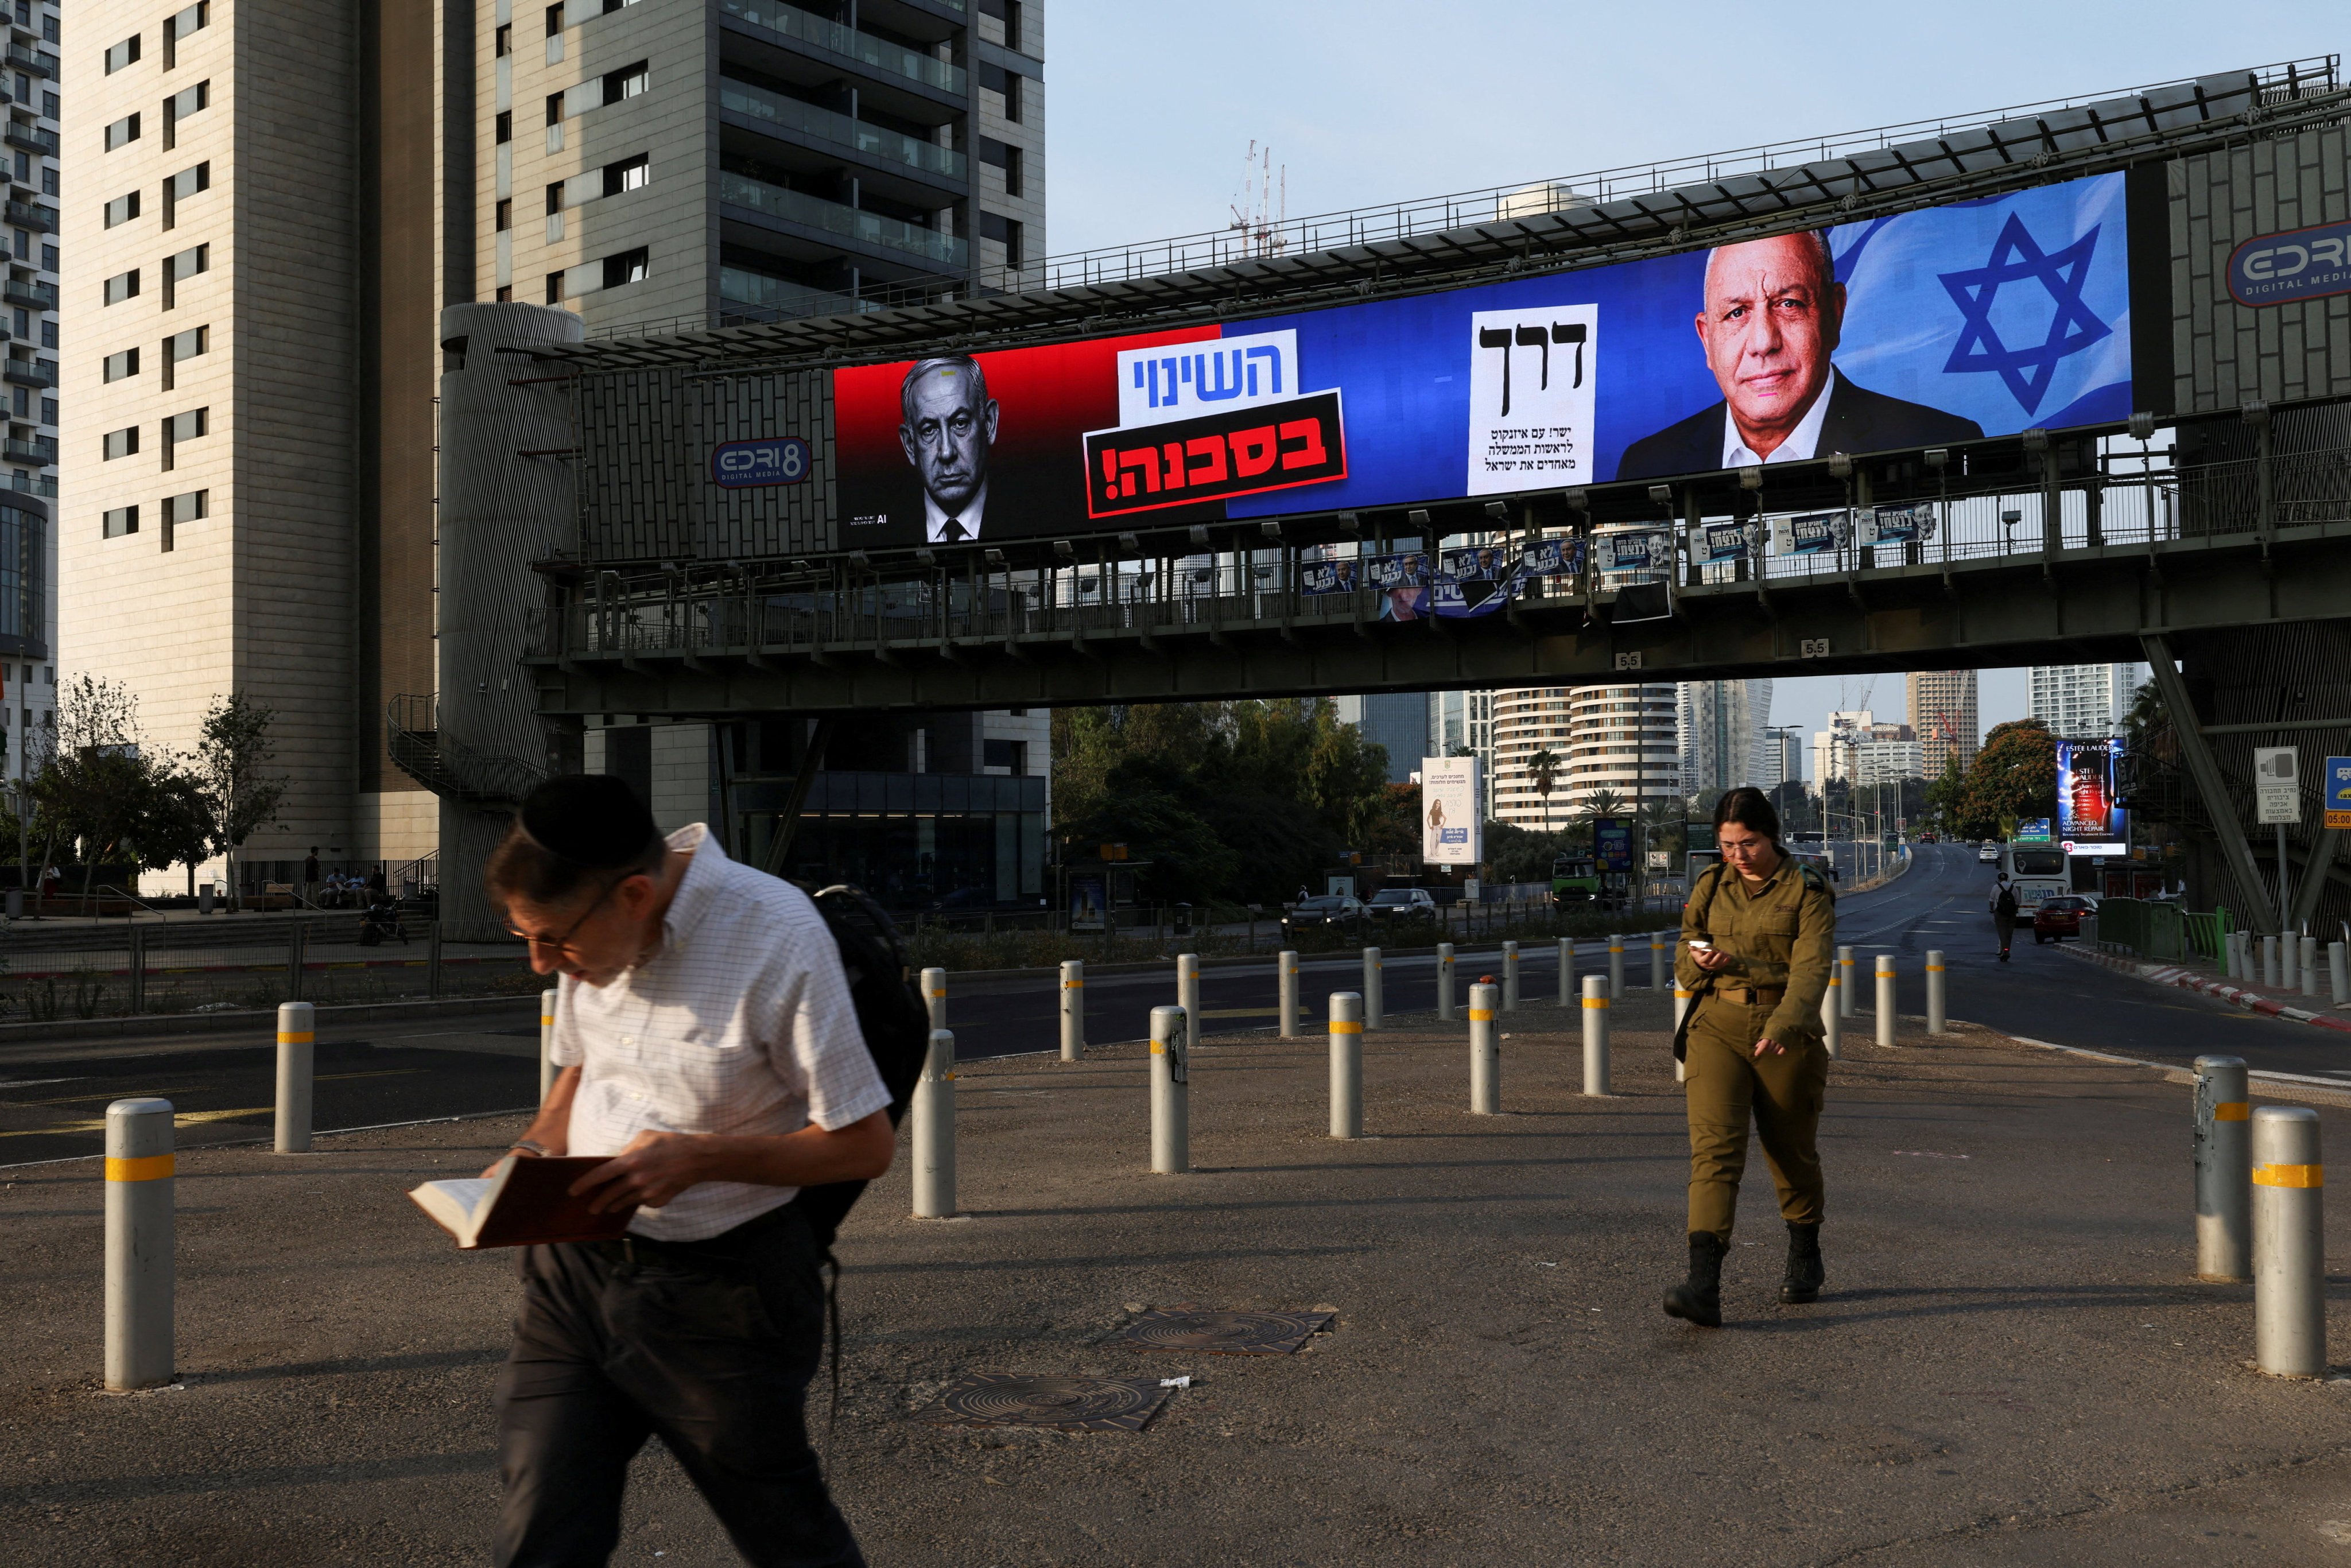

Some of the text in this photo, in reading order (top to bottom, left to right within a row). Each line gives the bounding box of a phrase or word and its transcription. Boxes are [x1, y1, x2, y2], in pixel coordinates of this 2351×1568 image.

[2246, 280, 2303, 295] DIGITAL
[1134, 345, 1282, 407] השינוי
[1479, 321, 1586, 417] דרך
[1491, 428, 1571, 443] ישר! עם איזנקוט
[1489, 439, 1573, 455] לראשות הממשלה
[1102, 417, 1327, 499] בסכנה!
[1485, 457, 1575, 471] מאחדים את ישראל
[877, 514, 886, 523] AI
[1540, 545, 1554, 560] לא
[1384, 560, 1397, 573] לא
[1458, 553, 1472, 567] לא
[1318, 565, 1330, 579] לא
[1806, 643, 1824, 654] 5.5
[1620, 656, 1637, 666] 5.5
